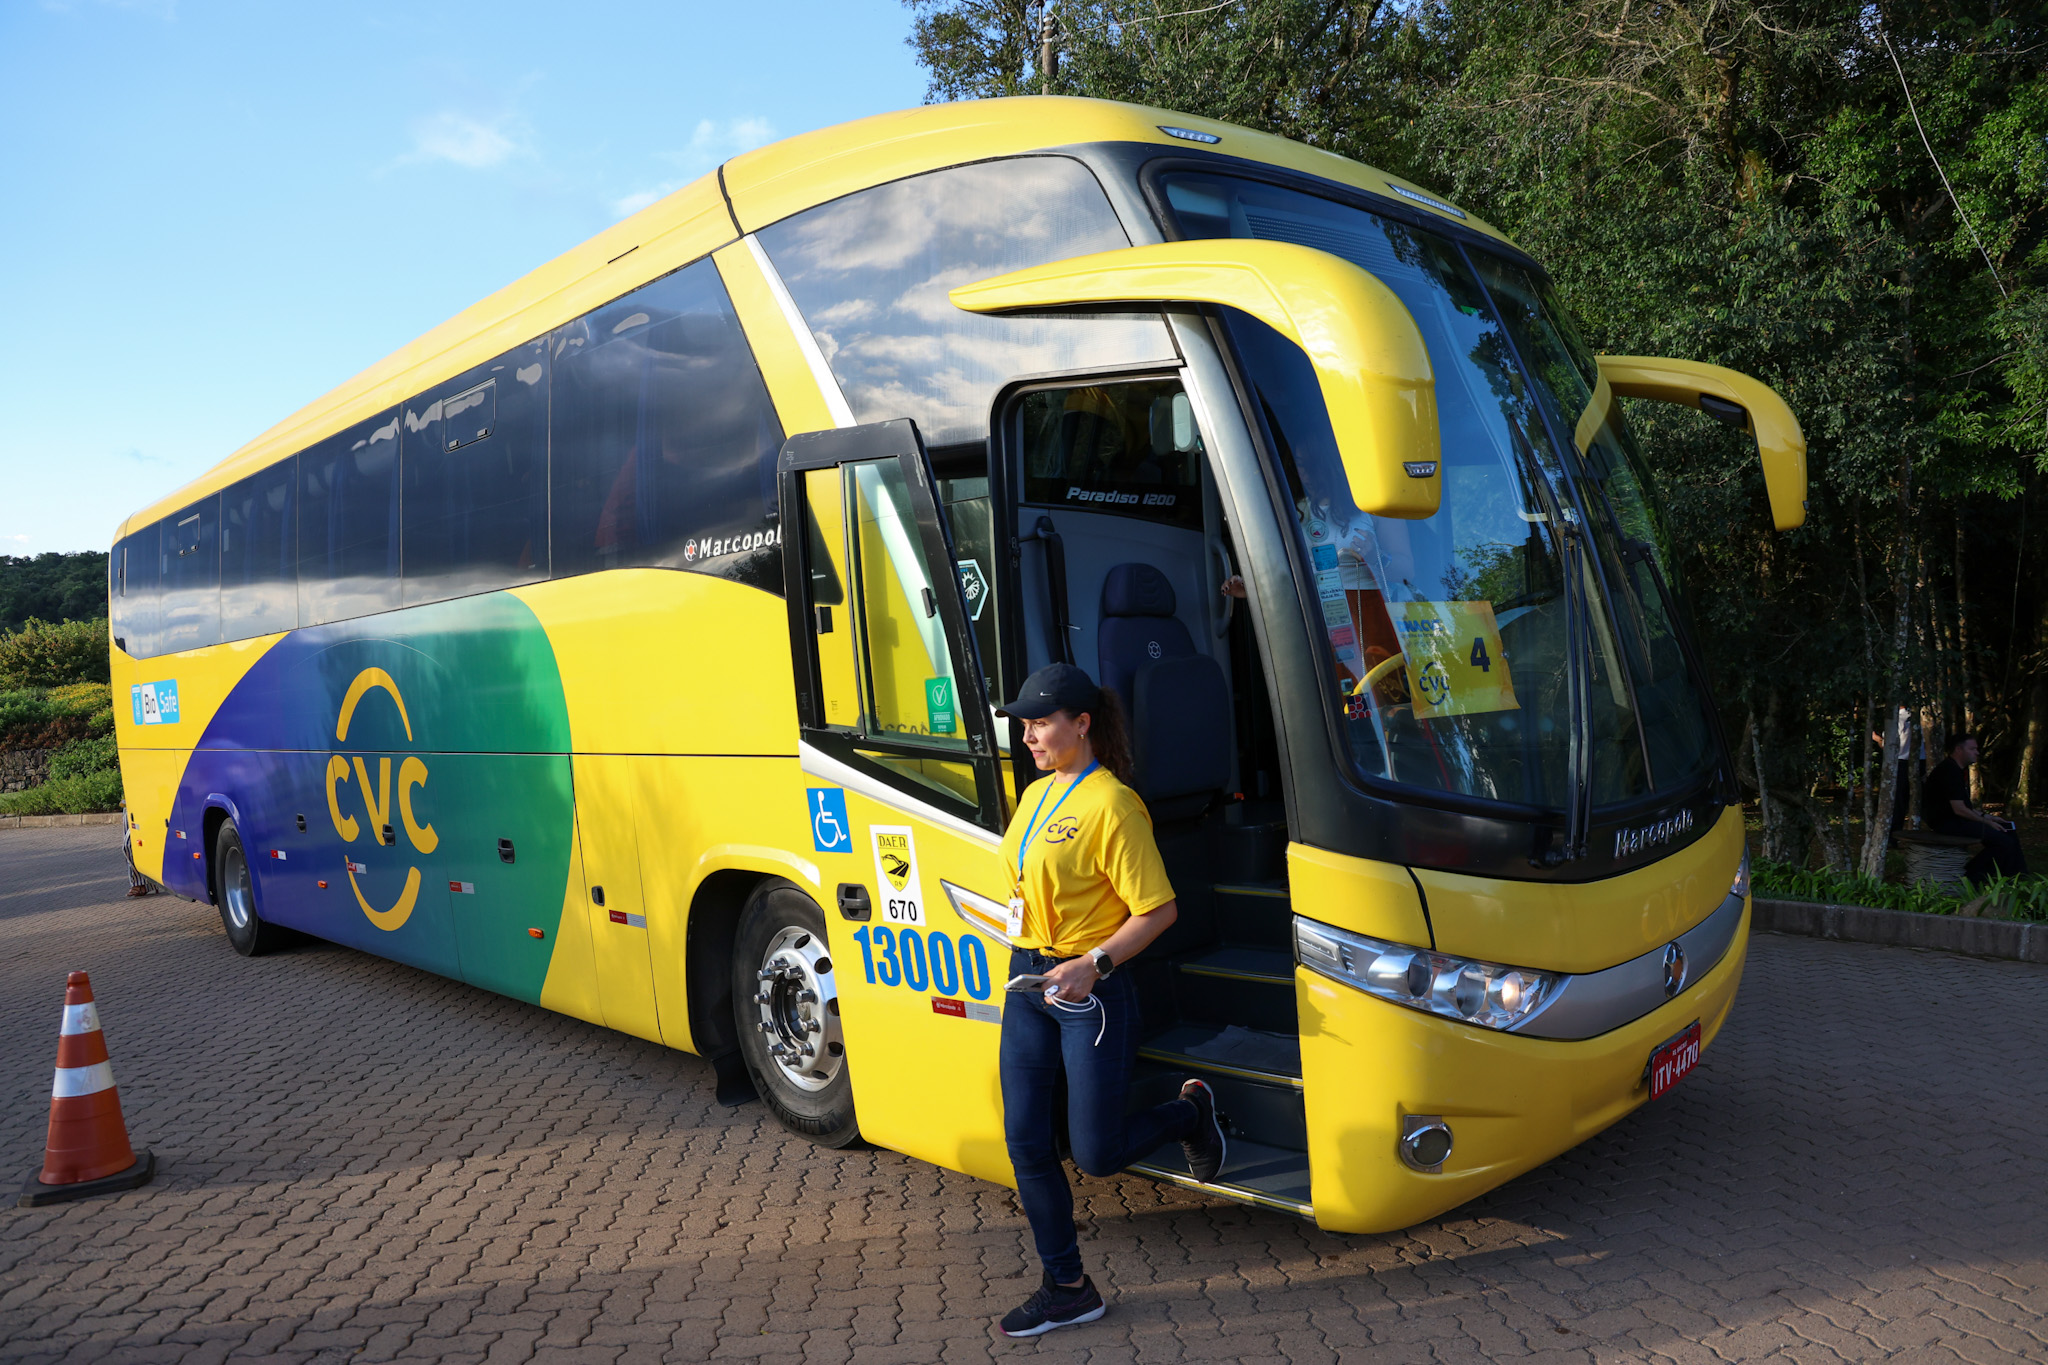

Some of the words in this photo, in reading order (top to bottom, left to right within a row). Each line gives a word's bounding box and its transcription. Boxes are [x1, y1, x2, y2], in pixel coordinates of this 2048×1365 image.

[1066, 486, 1140, 504] Paradiso
[1142, 492, 1177, 506] 1200
[699, 523, 783, 559] Marcopol
[1470, 636, 1491, 673] 4
[1419, 675, 1451, 692] CVC
[159, 689, 178, 714] Safe
[326, 754, 440, 855] CVC
[878, 835, 907, 848] DAER
[1047, 823, 1079, 840] CVC
[1613, 807, 1695, 860] Marcopolo
[888, 898, 918, 922] 670
[853, 925, 992, 1001] 13000
